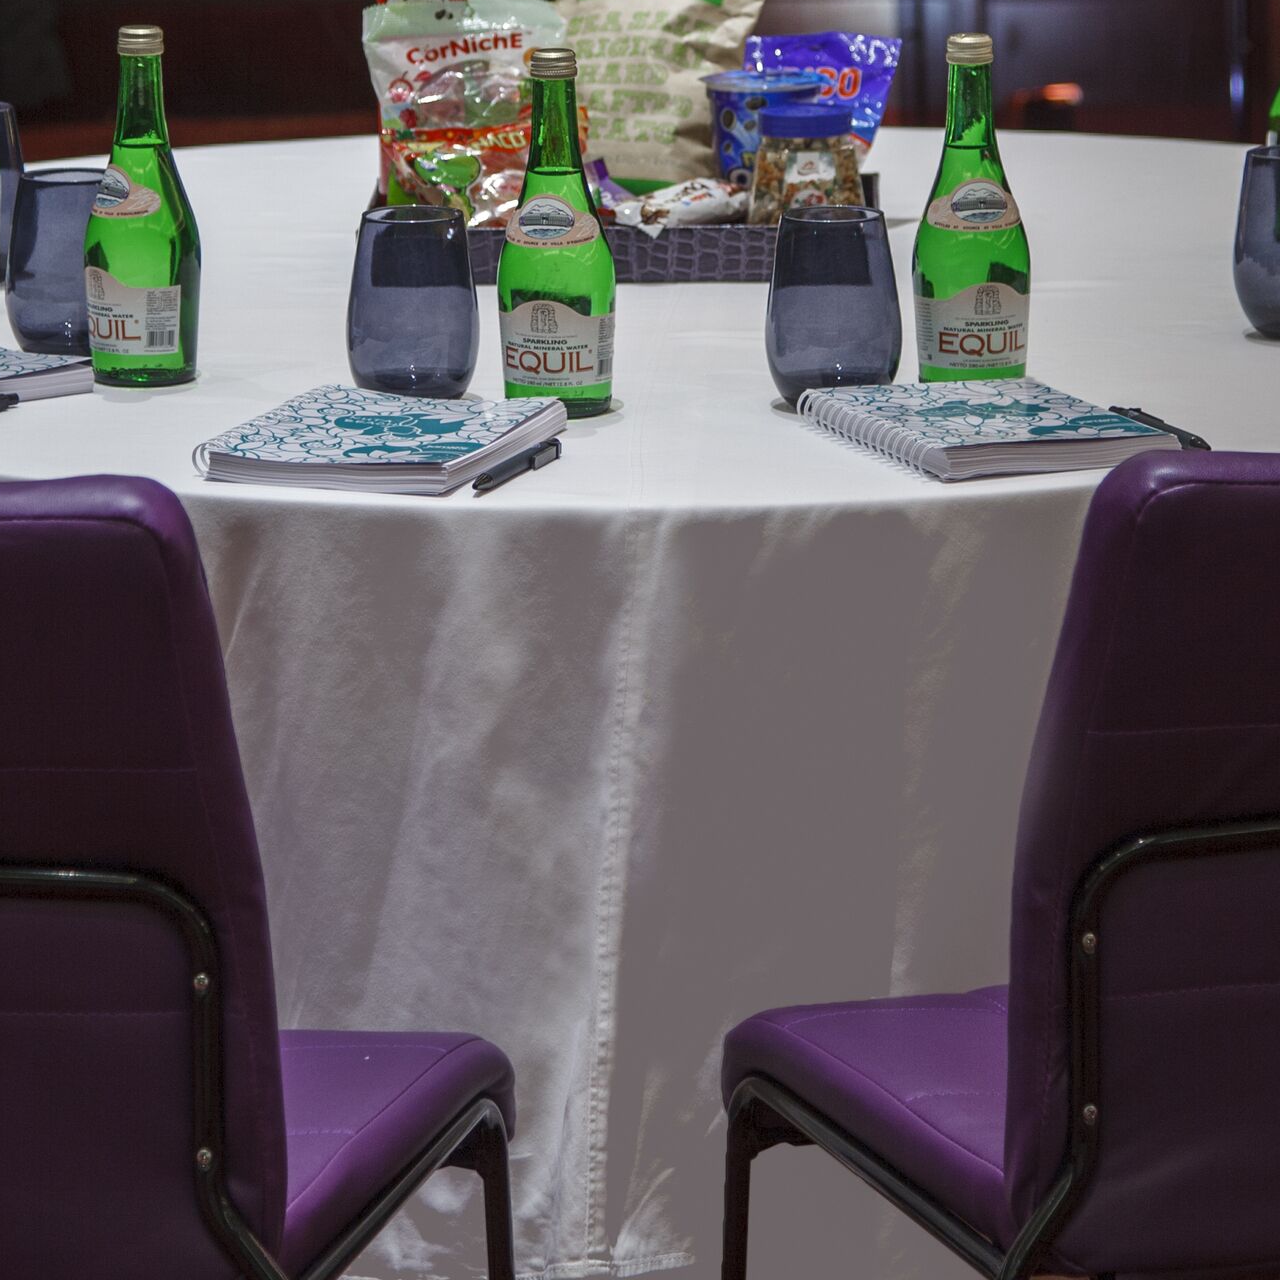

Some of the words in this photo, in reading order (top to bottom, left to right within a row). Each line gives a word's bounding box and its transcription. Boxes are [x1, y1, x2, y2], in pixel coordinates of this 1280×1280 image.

[965, 319, 1010, 327] SPARKLING
[507, 340, 532, 350] NATURAL
[522, 337, 568, 346] SPARKLING
[938, 329, 1025, 357] EQUIL
[505, 345, 594, 374] EQUIL
